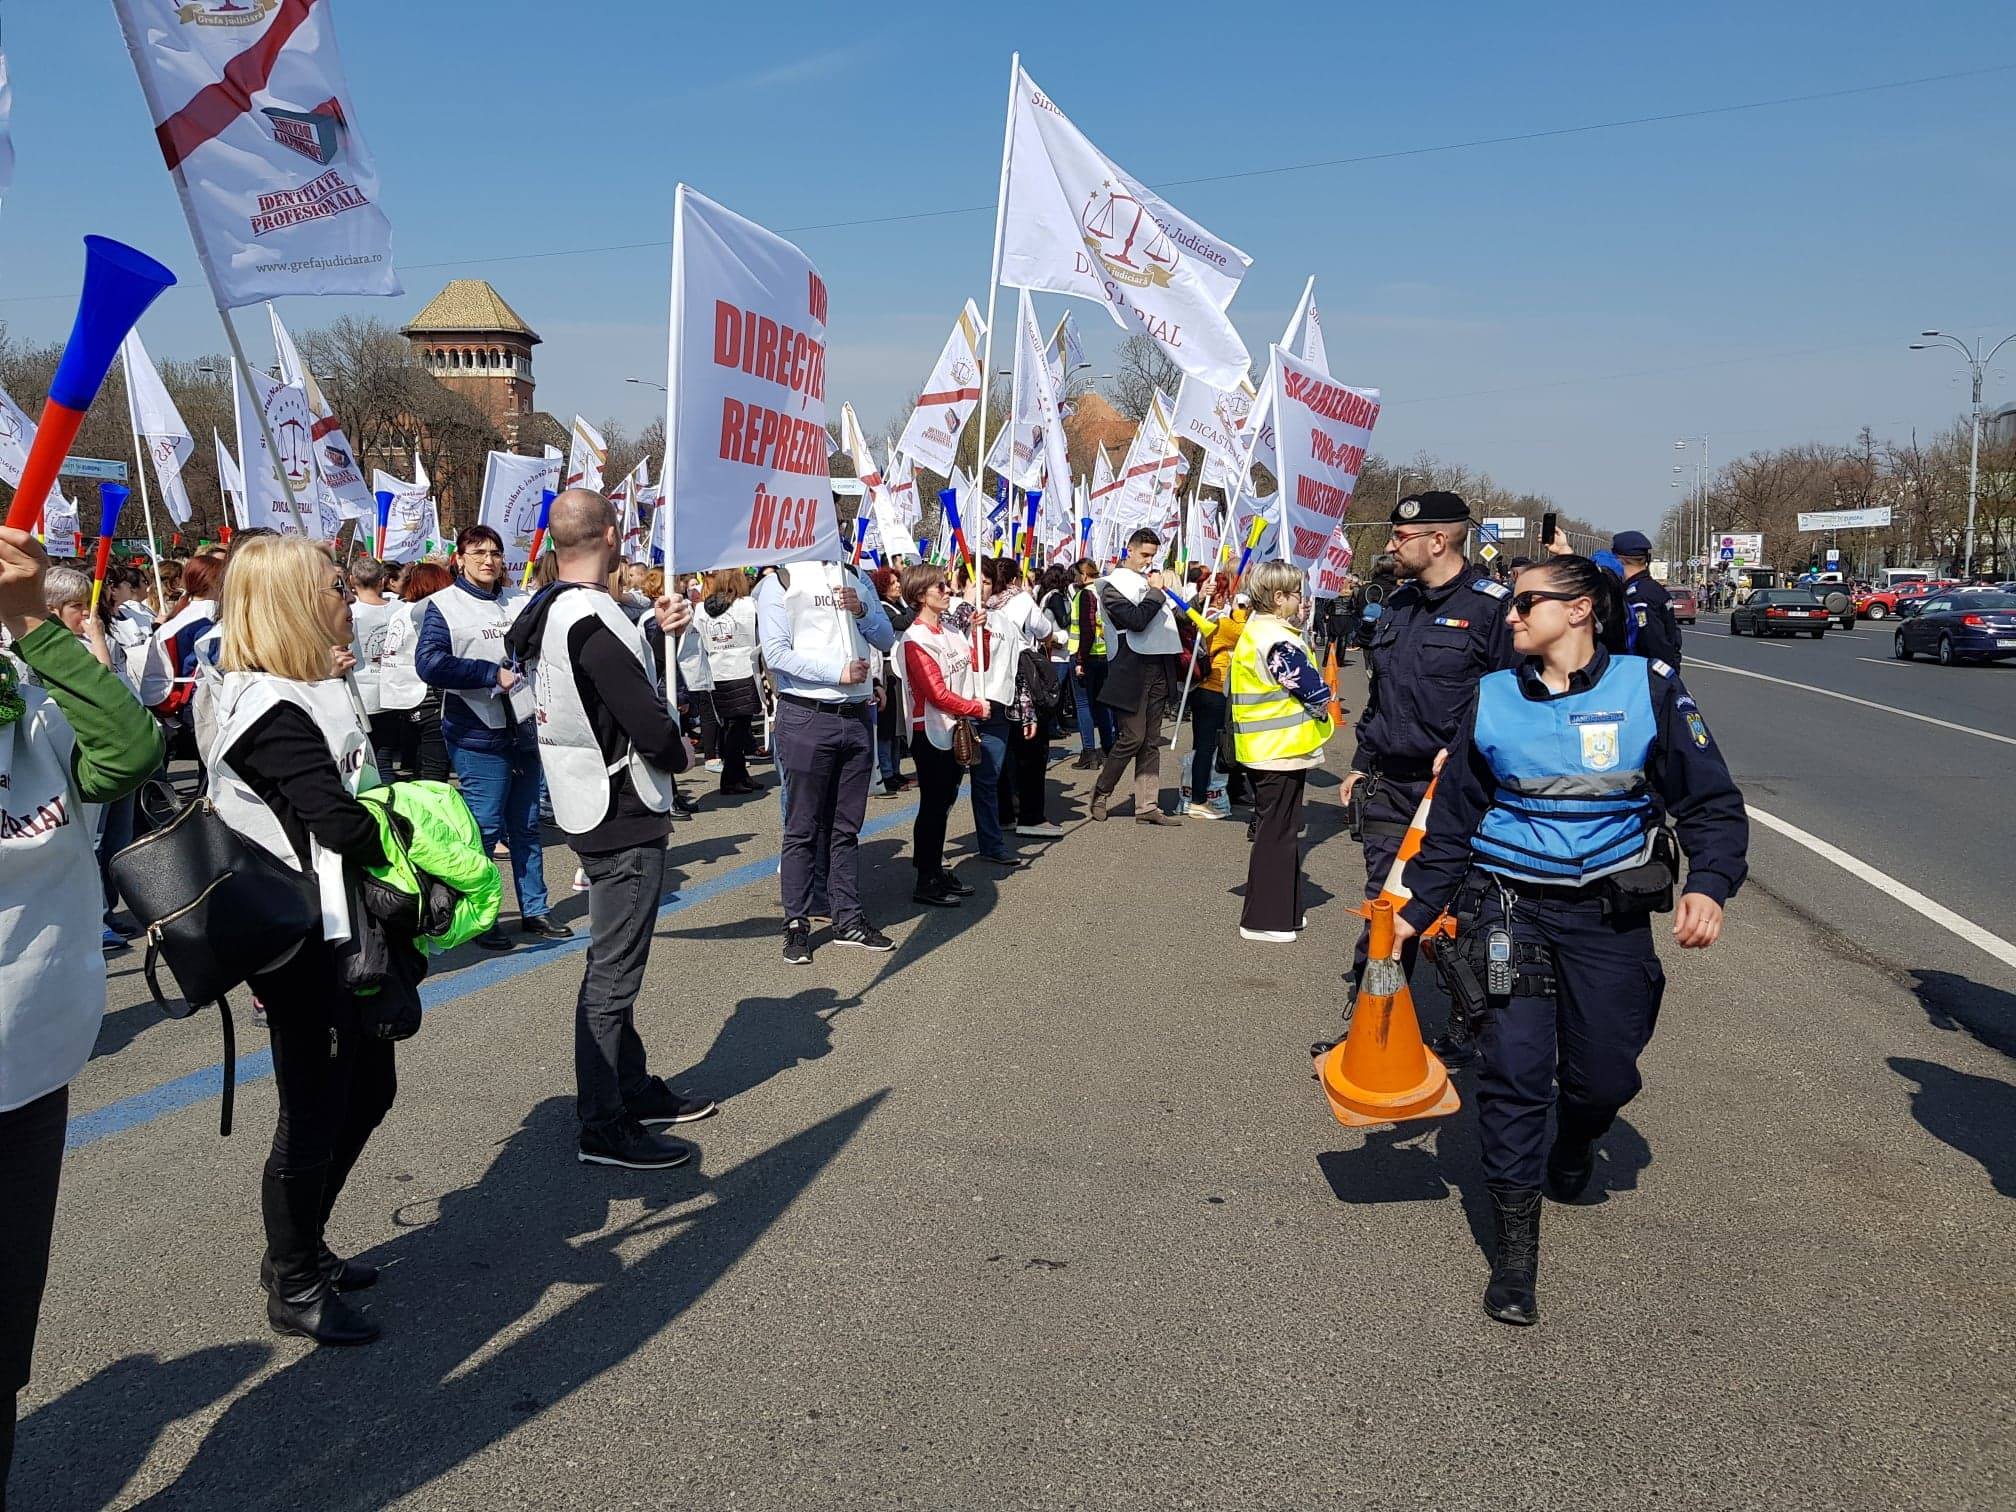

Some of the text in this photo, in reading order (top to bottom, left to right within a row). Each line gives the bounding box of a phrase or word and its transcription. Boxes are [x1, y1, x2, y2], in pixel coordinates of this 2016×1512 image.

[250, 187, 368, 234] PROFESIONALA
[258, 171, 345, 212] IDENTITATE
[256, 251, 383, 273] www.grefajudiciara.ro
[1169, 227, 1227, 267] Judiciare
[747, 482, 778, 549] ÎN
